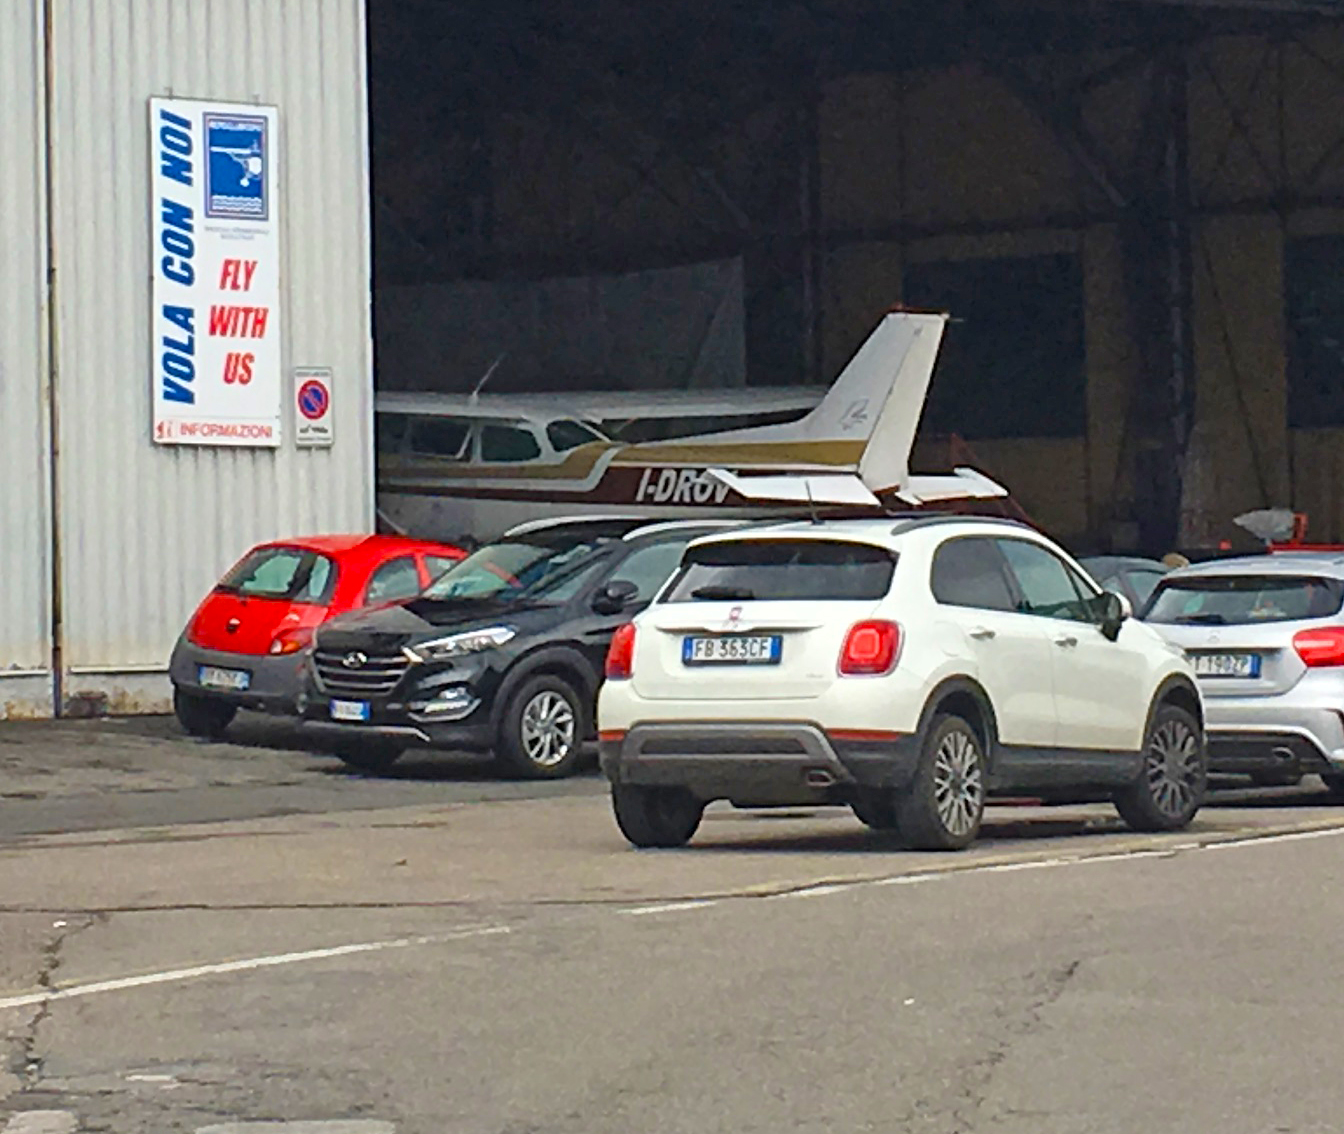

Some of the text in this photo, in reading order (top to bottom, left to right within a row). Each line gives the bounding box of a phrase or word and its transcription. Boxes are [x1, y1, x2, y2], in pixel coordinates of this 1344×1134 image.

[160, 108, 196, 405] VOLA CON NOI
[218, 258, 258, 292] FLY
[208, 304, 269, 339] WITH
[222, 352, 255, 386] US
[180, 421, 273, 439] INFORMAZIONI
[694, 638, 769, 658] FB 363CF
